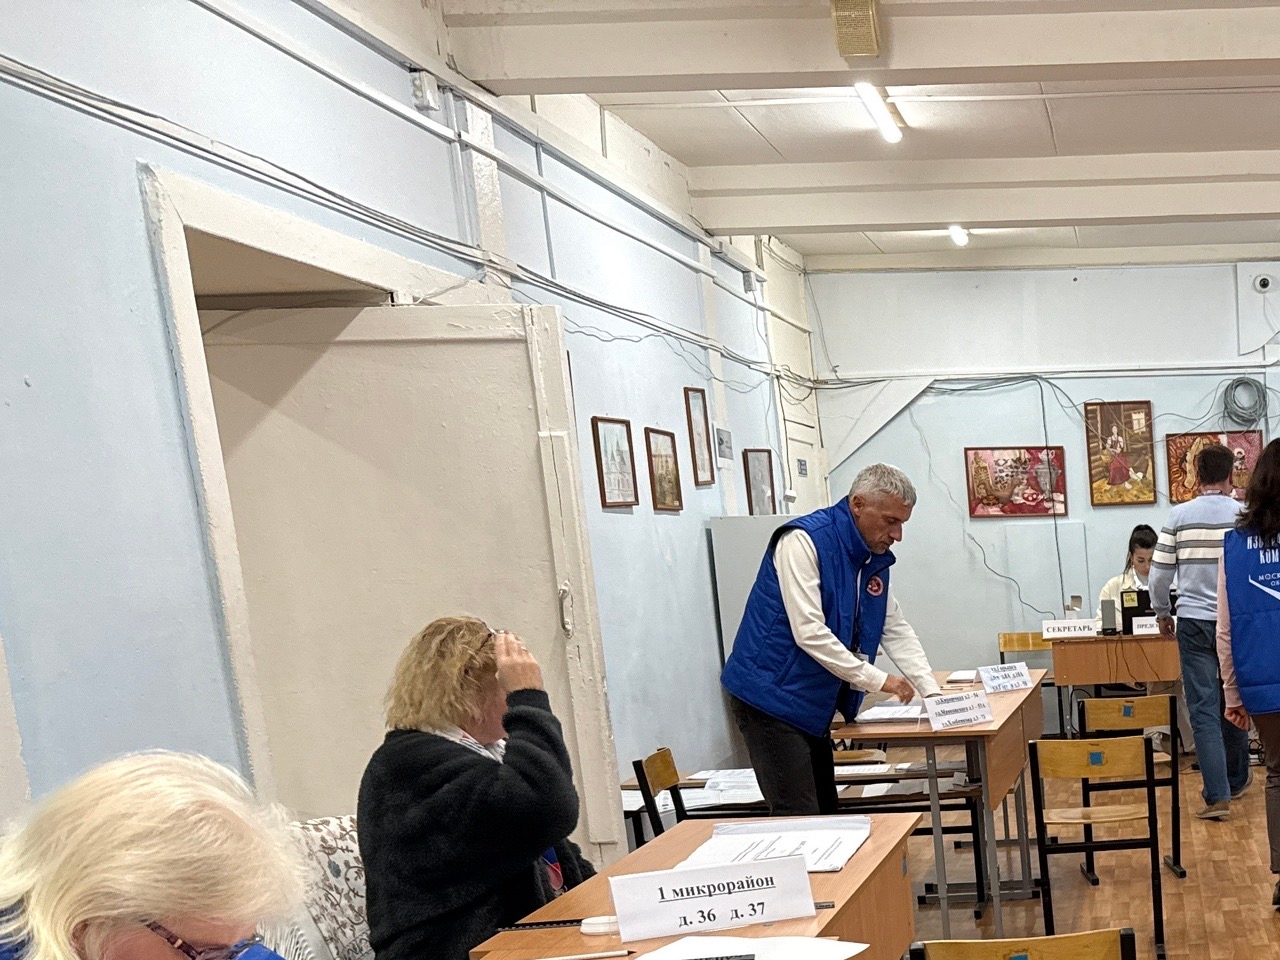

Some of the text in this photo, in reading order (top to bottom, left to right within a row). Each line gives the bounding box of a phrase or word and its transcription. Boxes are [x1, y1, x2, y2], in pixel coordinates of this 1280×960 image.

[1046, 624, 1093, 633] СЕКРЕТАРЬ
[658, 876, 775, 900] 1 микрорайон
[678, 901, 765, 928] д. 36 д. 37
